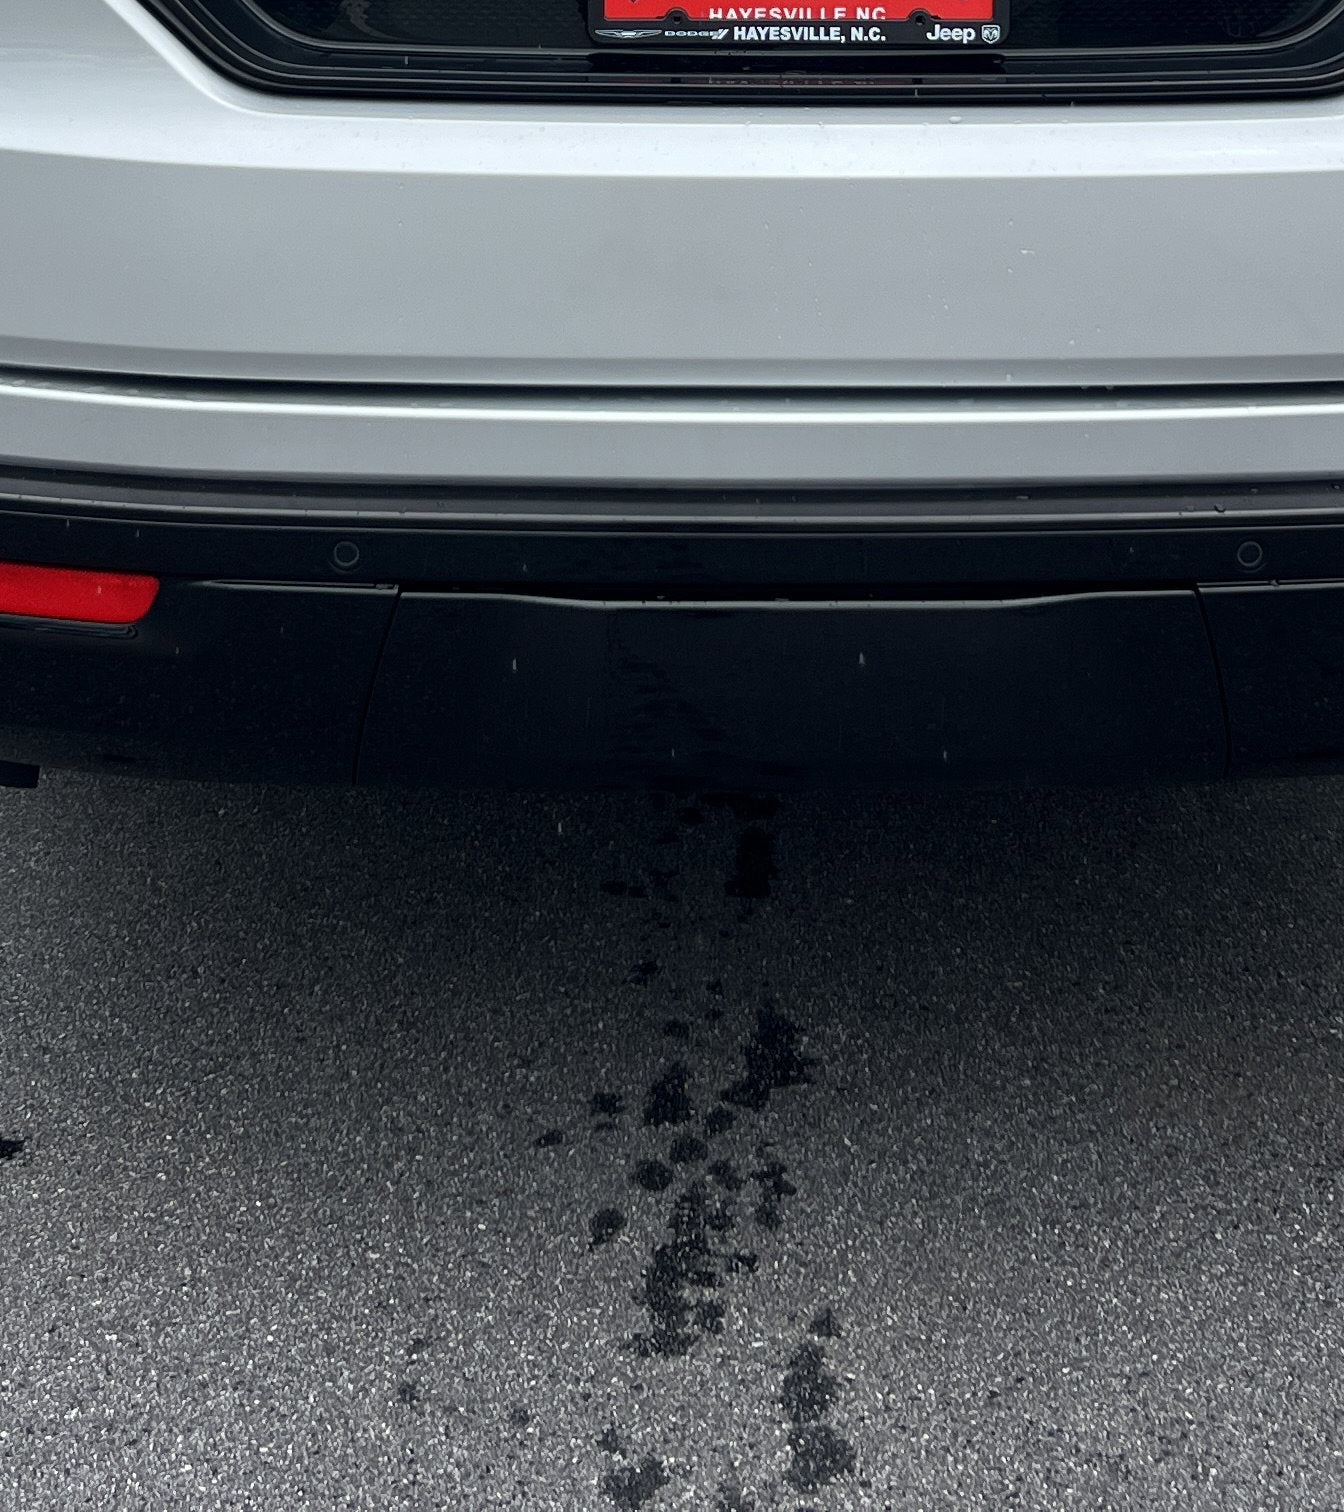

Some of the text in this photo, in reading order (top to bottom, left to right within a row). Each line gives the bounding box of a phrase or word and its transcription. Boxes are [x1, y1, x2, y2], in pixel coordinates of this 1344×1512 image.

[733, 26, 846, 43] HAYESVILLE,
[851, 26, 887, 41] N.C.
[927, 25, 976, 44] Jeep
